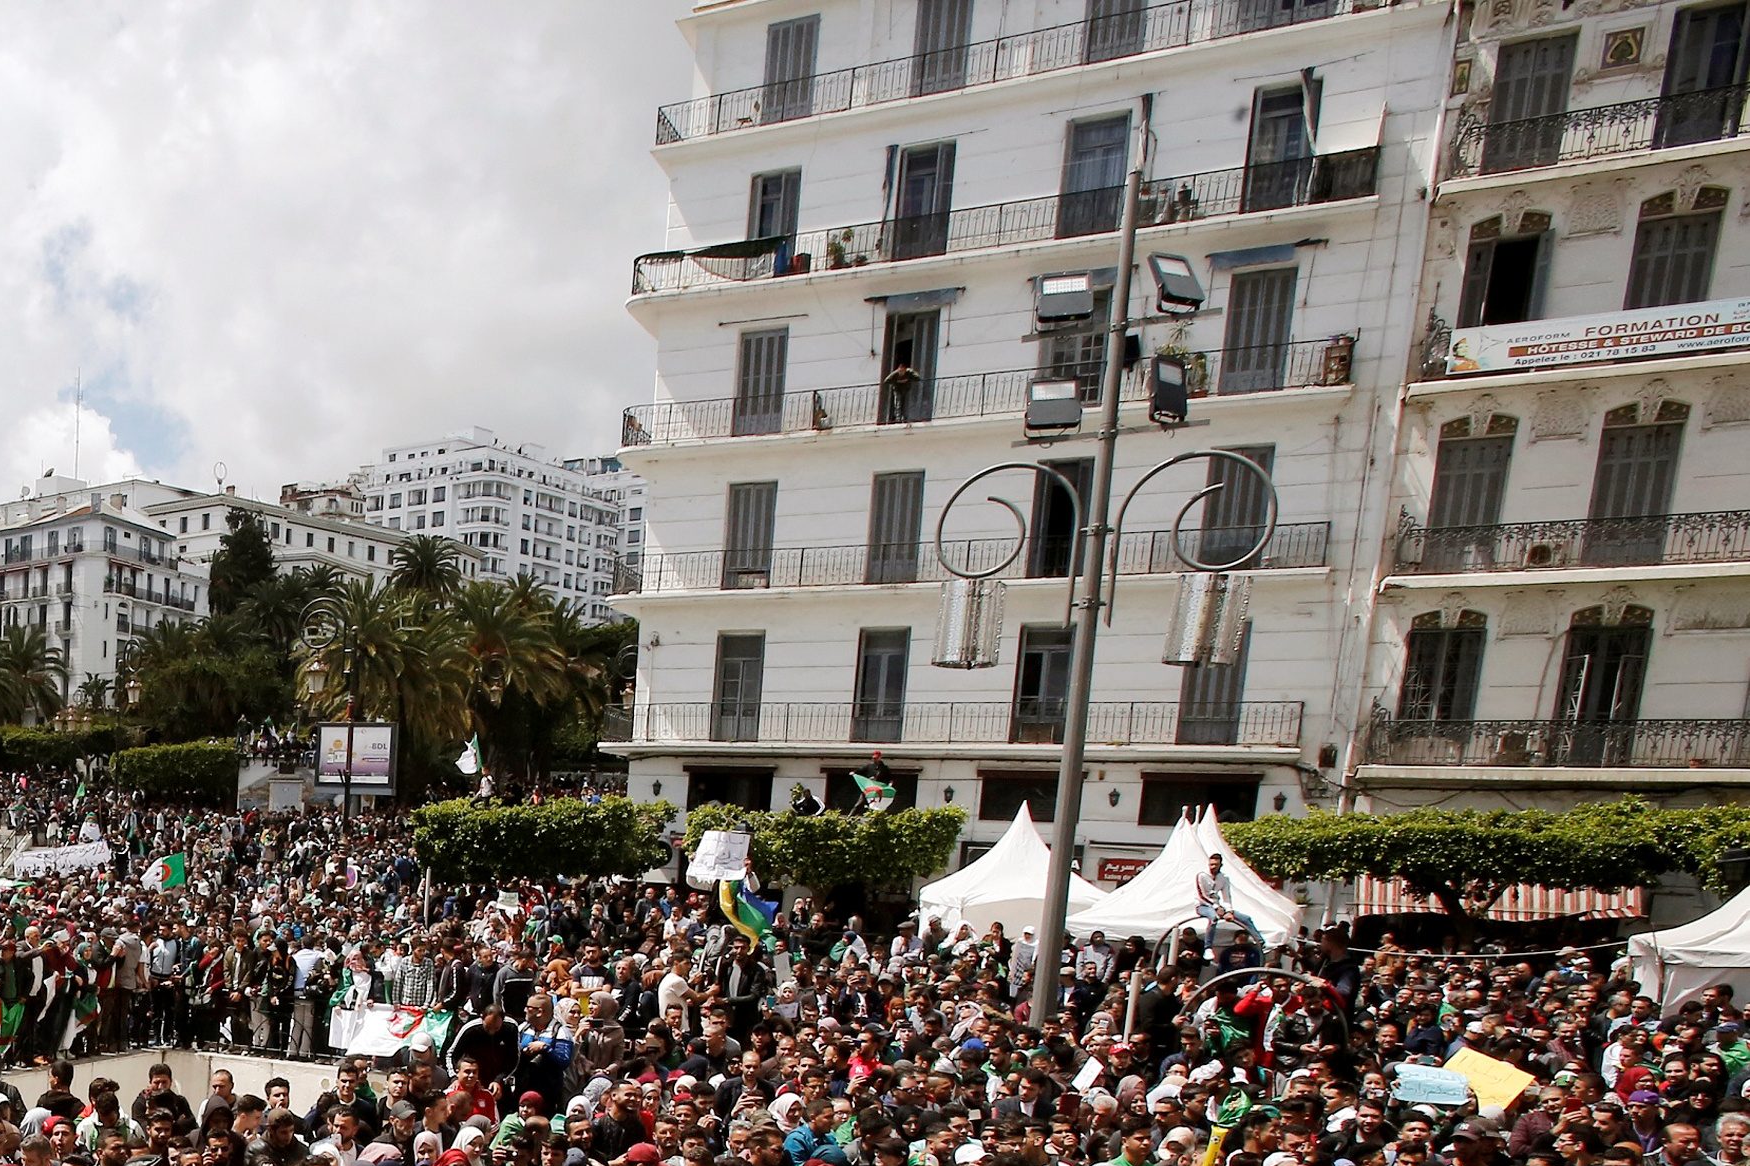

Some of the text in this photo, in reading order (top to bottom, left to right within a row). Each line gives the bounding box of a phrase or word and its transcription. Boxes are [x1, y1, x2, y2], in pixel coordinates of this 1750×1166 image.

[1585, 313, 1720, 337] FORMATION
[1507, 332, 1570, 344] AEROFORM
[1527, 341, 1597, 355] HÔTESSE
[1603, 338, 1614, 347] &
[1619, 329, 1698, 345] STEWARD
[1703, 326, 1725, 337] DE
[1514, 355, 1557, 366] Appelez
[1580, 351, 1600, 359] 021
[1641, 344, 1656, 353] 83
